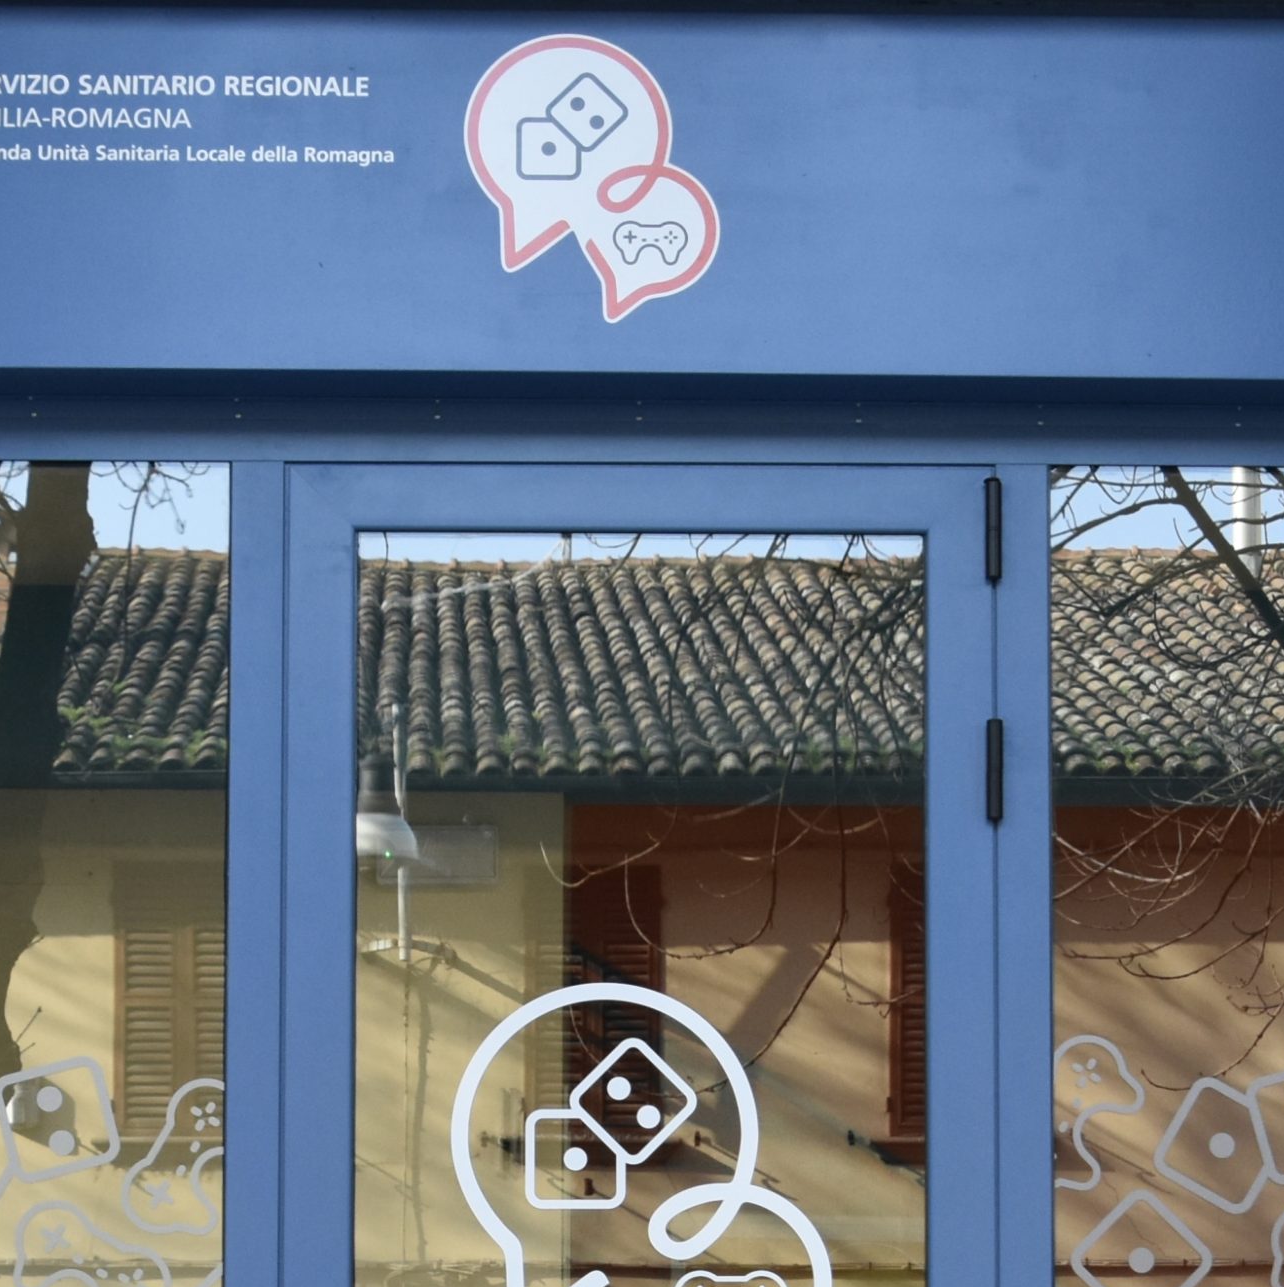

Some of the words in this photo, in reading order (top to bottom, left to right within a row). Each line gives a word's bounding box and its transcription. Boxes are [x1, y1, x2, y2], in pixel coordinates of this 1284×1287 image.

[77, 73, 217, 97] SANITARIO
[224, 74, 370, 98] REGIONALE
[37, 142, 90, 162] Unità
[95, 143, 181, 162] Sanitaria
[186, 144, 247, 163] Locale
[251, 144, 299, 163] della
[303, 146, 395, 167] Romagna
